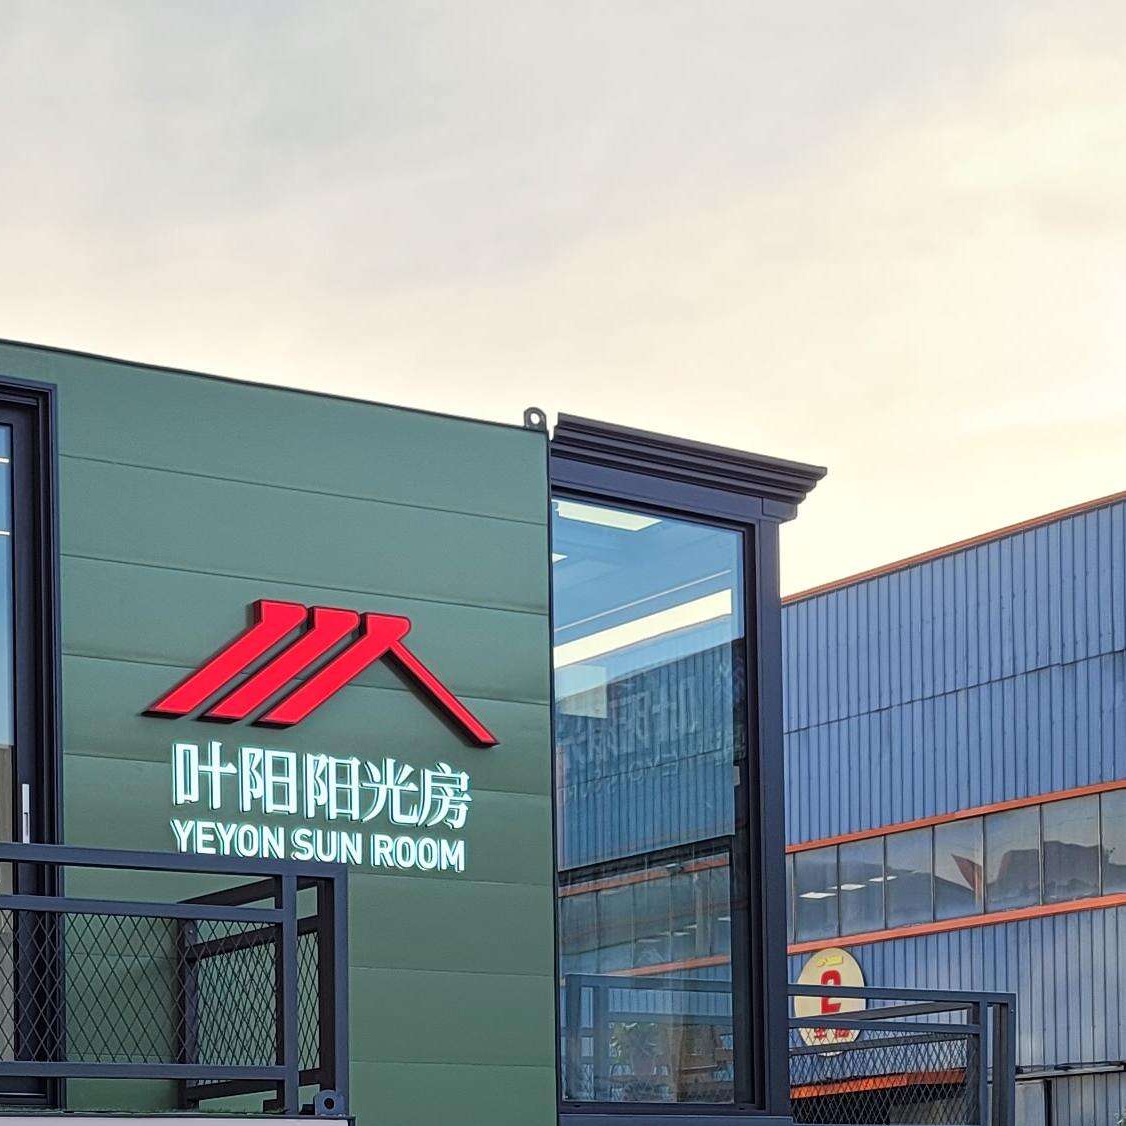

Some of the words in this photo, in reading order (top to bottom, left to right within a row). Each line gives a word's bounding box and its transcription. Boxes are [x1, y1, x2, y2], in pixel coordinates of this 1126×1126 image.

[172, 741, 472, 829] 叶阳阳光房
[170, 818, 285, 860] YEYON
[291, 825, 363, 865] SUN
[370, 833, 465, 872] ROOM
